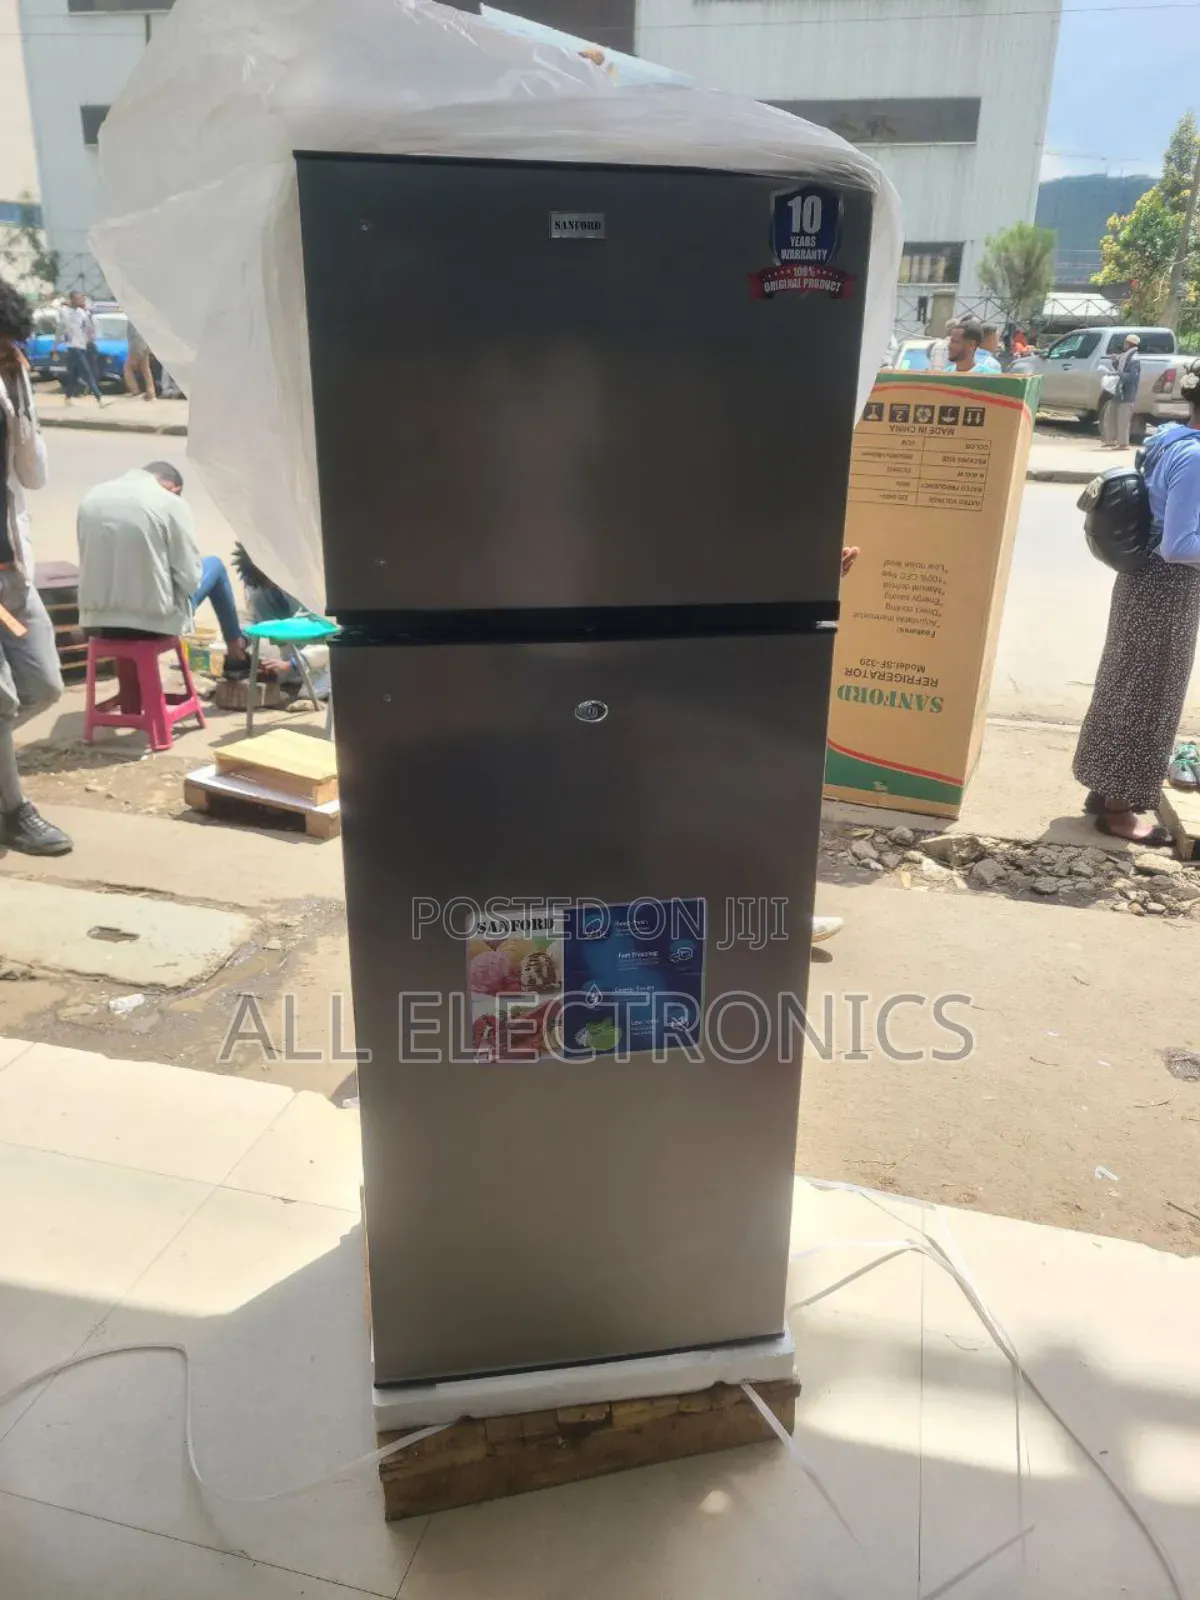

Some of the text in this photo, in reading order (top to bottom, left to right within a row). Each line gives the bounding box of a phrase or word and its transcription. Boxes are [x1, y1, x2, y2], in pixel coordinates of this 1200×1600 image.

[787, 194, 822, 234] 10
[554, 220, 602, 230] SANFORD
[790, 236, 816, 247] YEARS
[780, 249, 828, 260] WARRANTY
[793, 265, 816, 277] 100%
[764, 279, 842, 292] ORIGINAL PRODUCT
[889, 424, 955, 436] MADE IN CHINA
[959, 498, 981, 506] RATED
[899, 572, 919, 580] CFC
[844, 667, 939, 688] REFRIGERATOR
[837, 684, 944, 714] SANFORD
[476, 918, 554, 935] SANFORD
